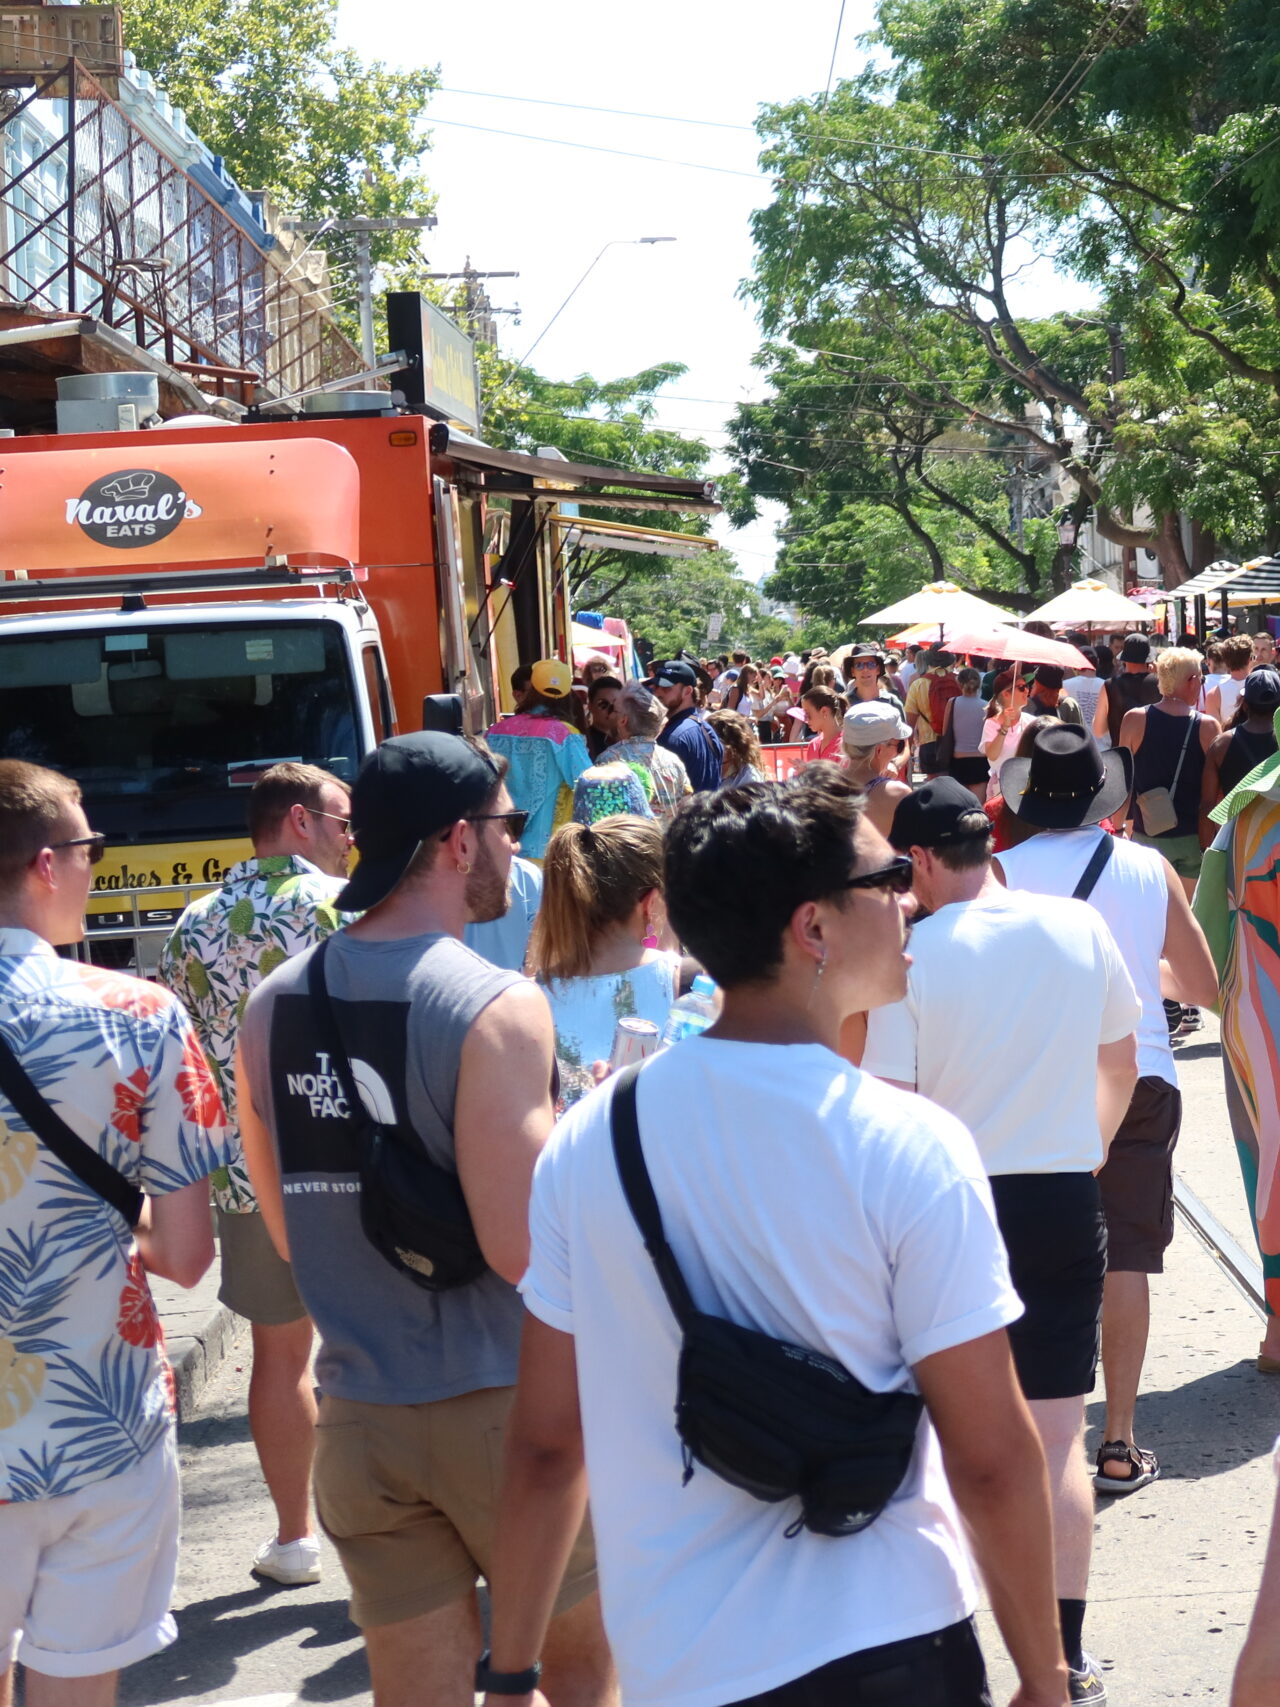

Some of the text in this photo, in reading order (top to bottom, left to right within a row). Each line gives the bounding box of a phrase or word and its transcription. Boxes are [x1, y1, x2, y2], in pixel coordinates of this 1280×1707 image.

[65, 491, 203, 525] Naval's
[106, 523, 156, 537] EATS
[94, 864, 161, 891] cakes
[171, 862, 193, 885] &
[98, 911, 174, 925] US
[287, 1073, 345, 1097] NORT
[309, 1096, 351, 1119] FAC
[283, 1182, 329, 1194] NEVER
